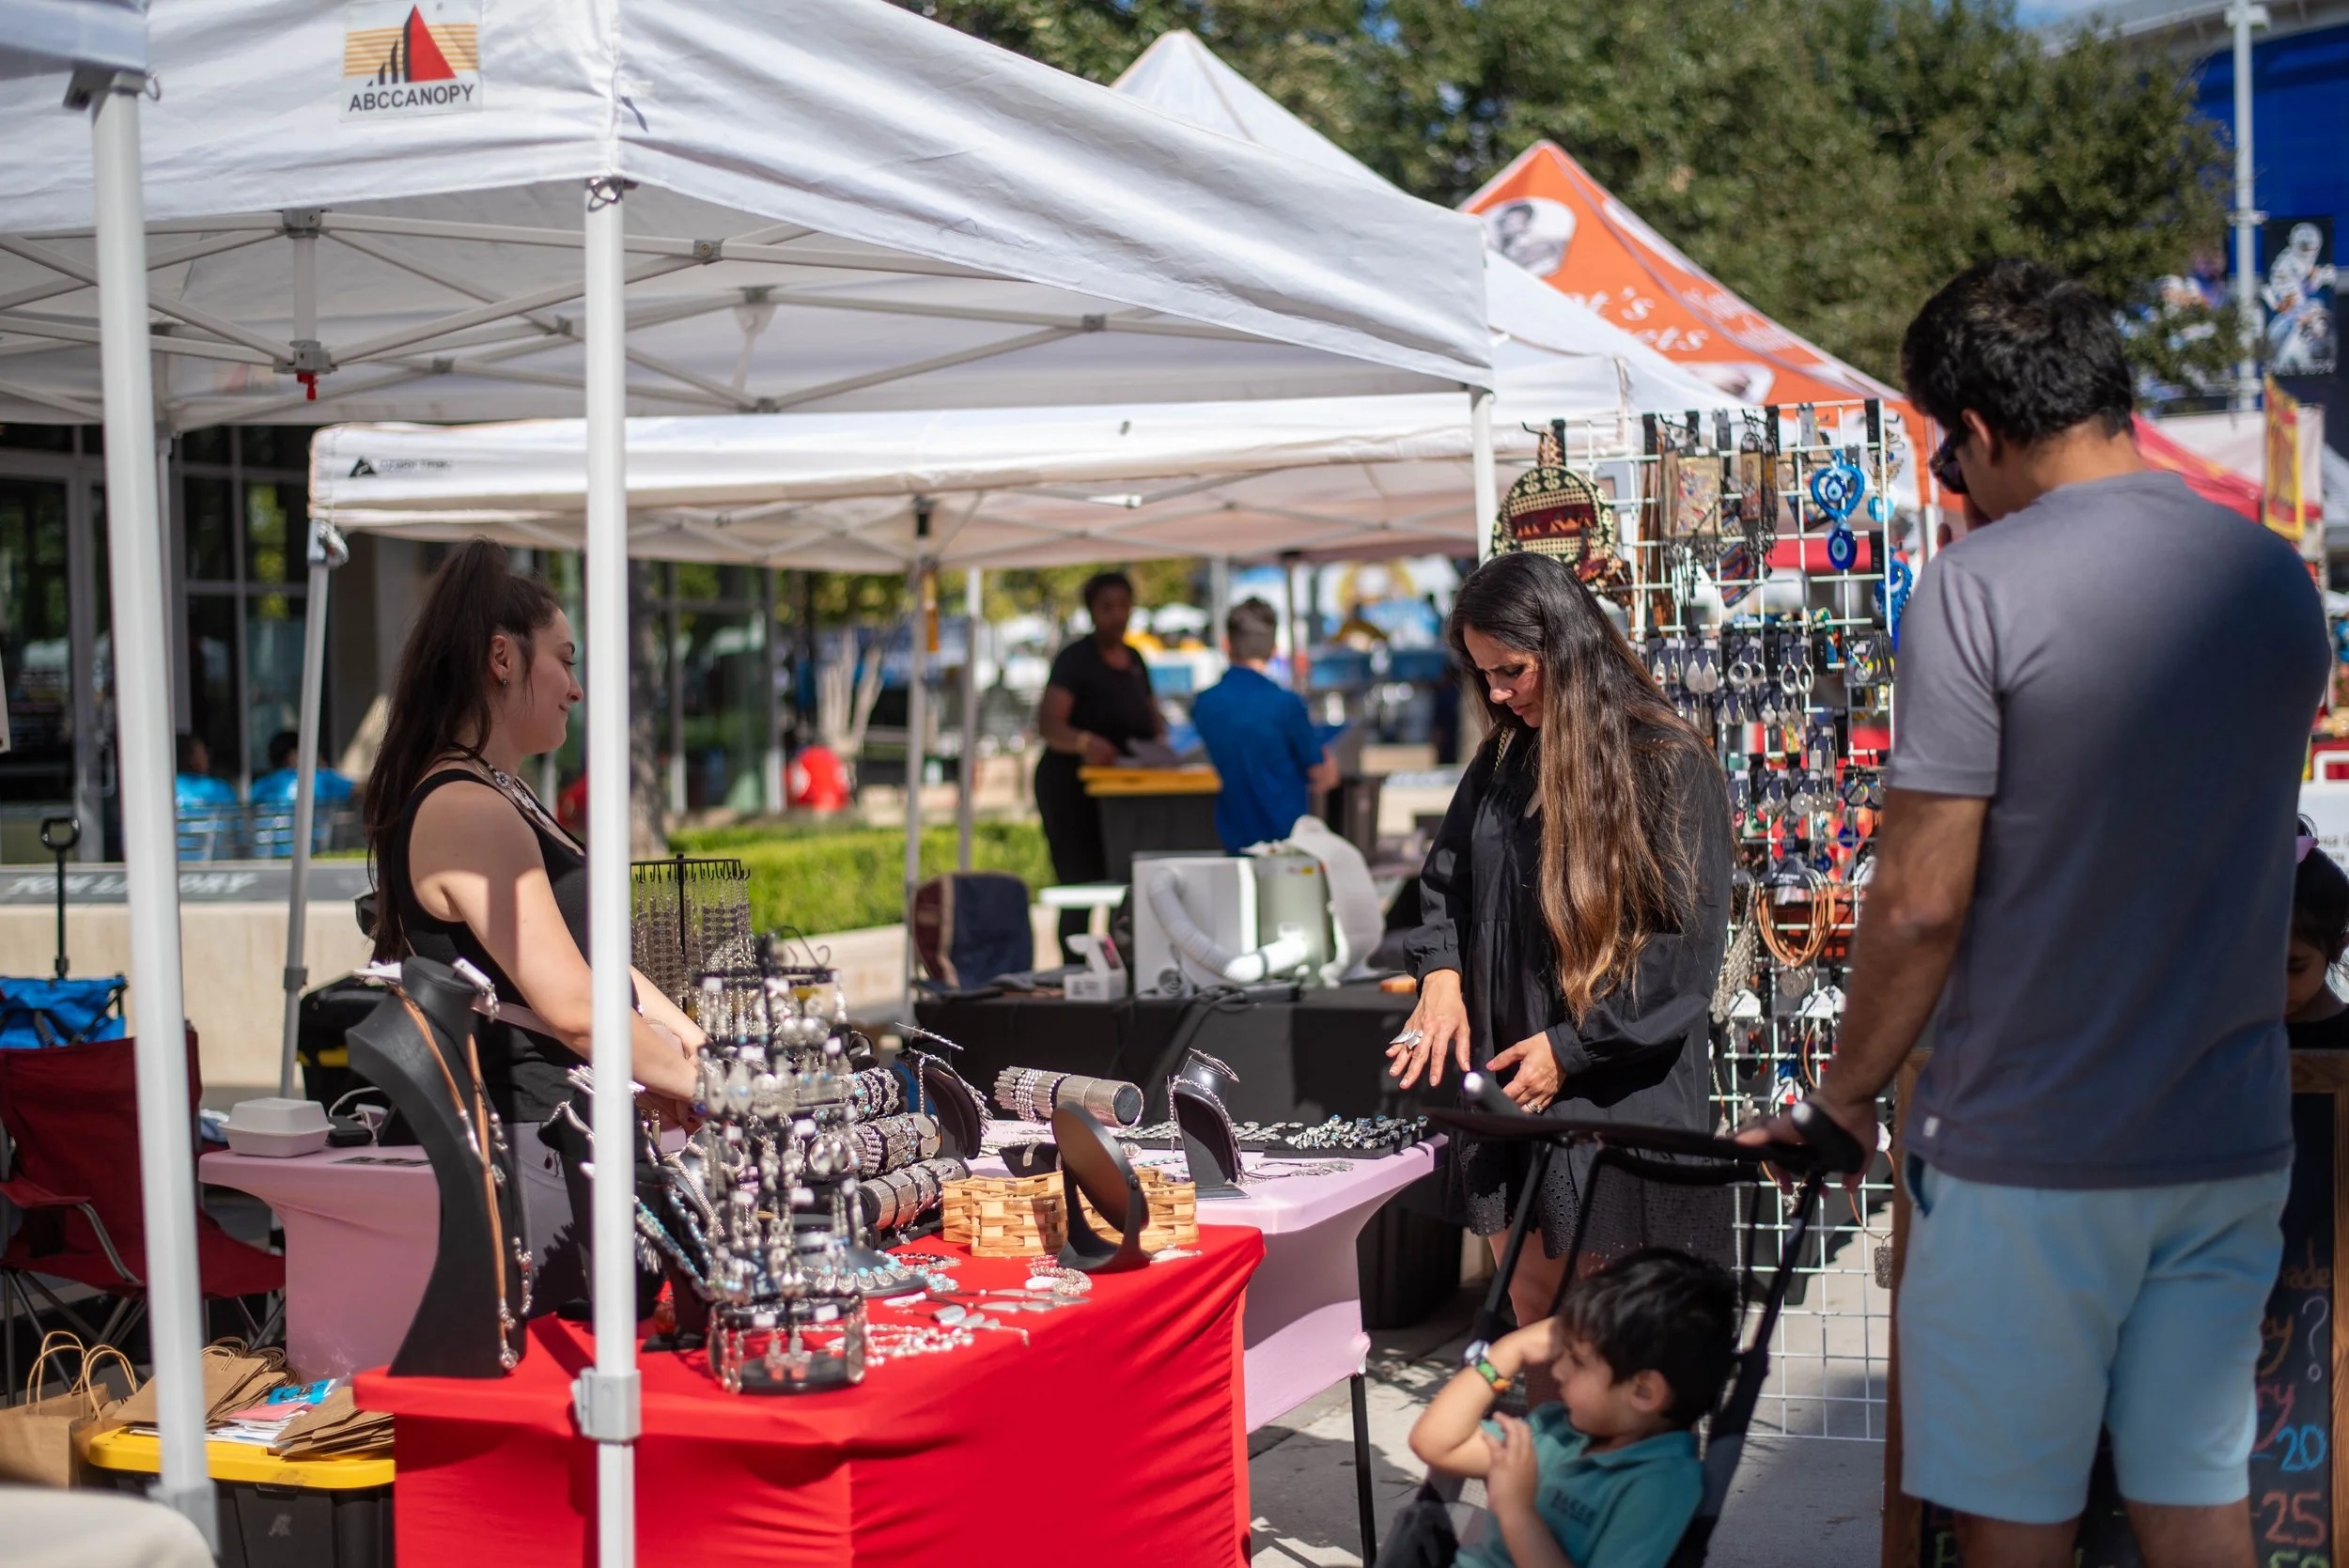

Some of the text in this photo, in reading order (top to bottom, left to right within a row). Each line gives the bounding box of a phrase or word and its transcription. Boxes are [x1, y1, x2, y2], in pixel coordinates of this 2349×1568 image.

[349, 84, 474, 112] ABCCANOPY
[2276, 1423, 2327, 1472] 20
[2261, 1489, 2327, 1547] 25
